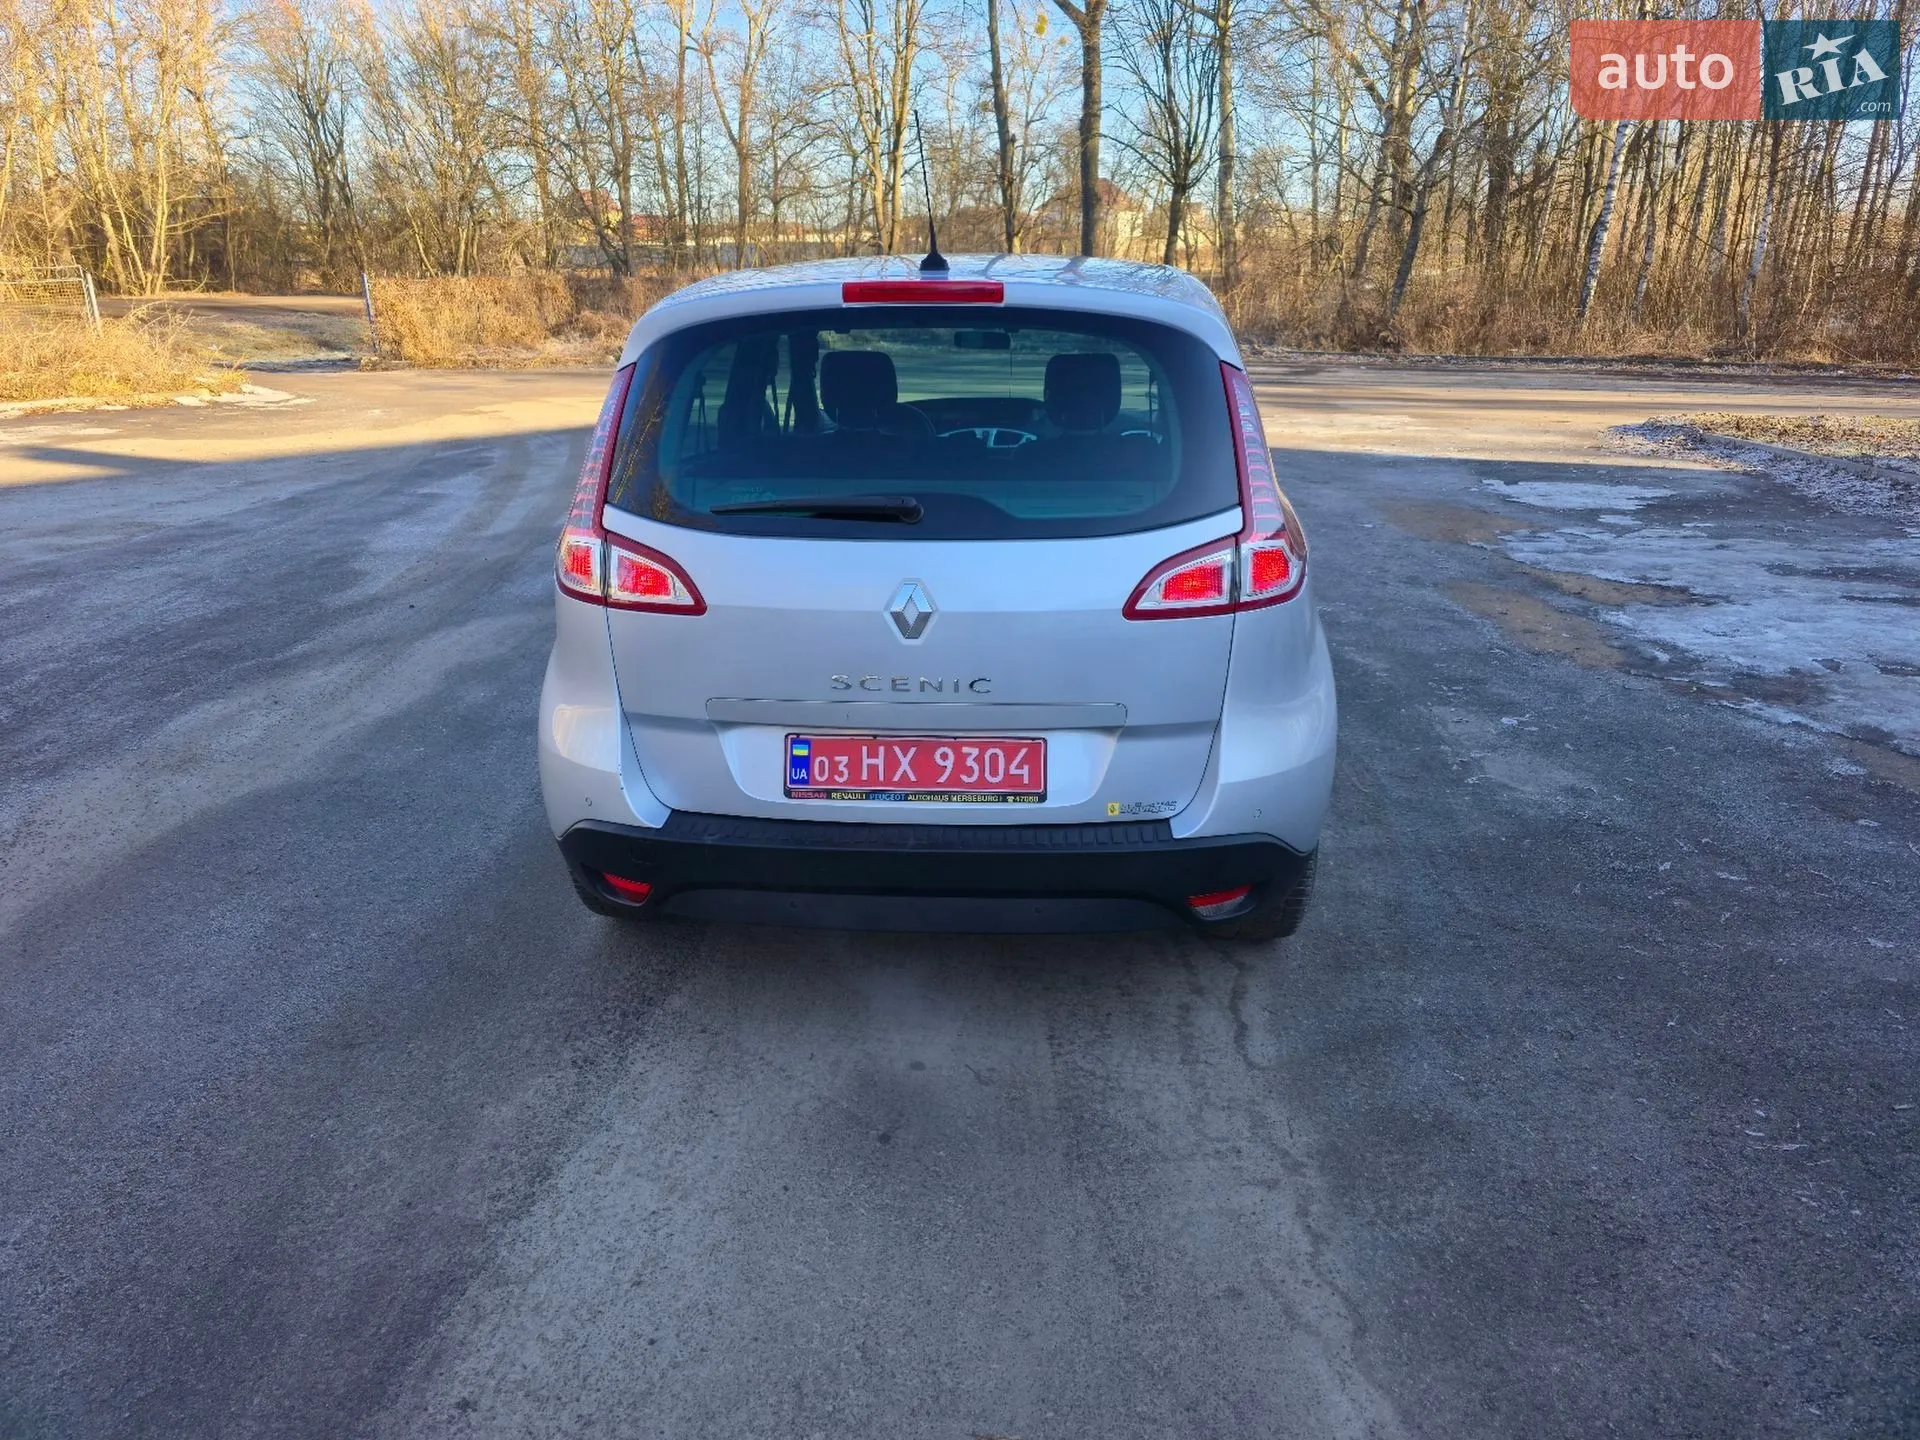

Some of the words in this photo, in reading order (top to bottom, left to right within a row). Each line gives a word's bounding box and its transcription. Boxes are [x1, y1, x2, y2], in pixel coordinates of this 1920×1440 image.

[831, 674, 992, 694] SCENIC
[813, 756, 849, 782] 03
[860, 745, 918, 782] HX
[932, 747, 1030, 785] 9304
[791, 768, 808, 780] UA
[791, 791, 827, 799] NISSAN
[831, 792, 866, 800] RENAULT
[869, 792, 905, 801] PEUGEOT
